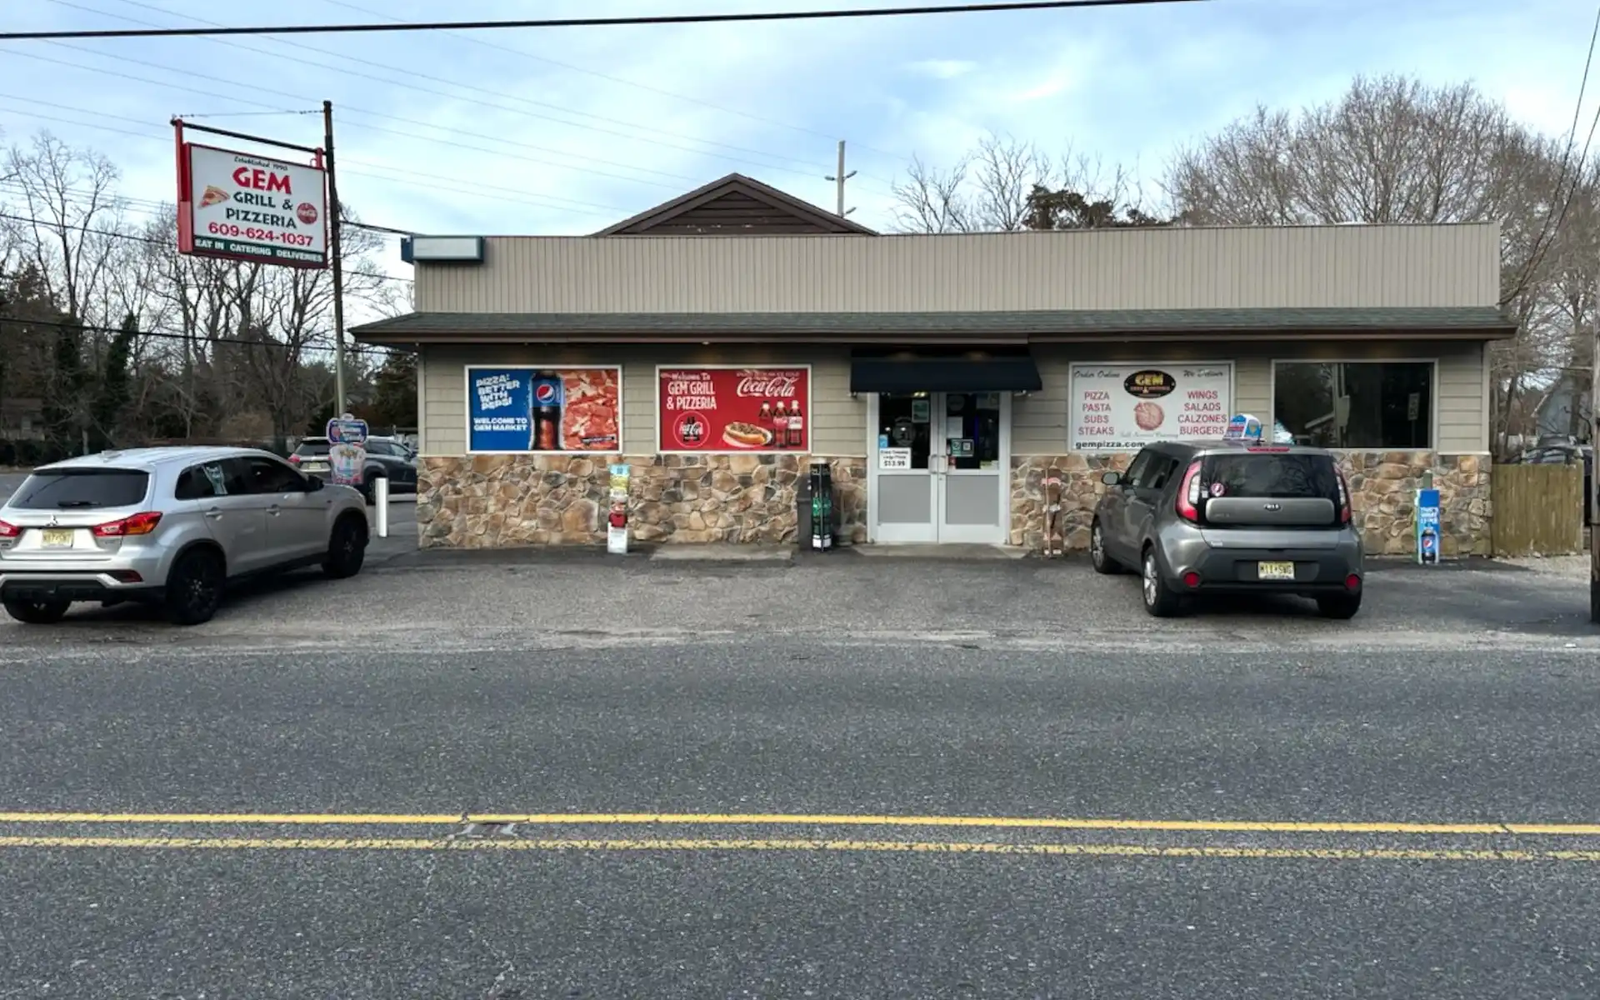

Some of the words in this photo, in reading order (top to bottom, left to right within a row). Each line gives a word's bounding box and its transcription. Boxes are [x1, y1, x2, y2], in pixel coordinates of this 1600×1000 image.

[232, 166, 292, 195] GEM
[233, 191, 276, 208] GRILL
[282, 199, 293, 211] &
[226, 207, 297, 229] PIZZERIA
[208, 221, 313, 247] 609-624-1037
[195, 239, 212, 249] EAT
[215, 241, 224, 250] IN
[230, 243, 272, 256] CATERING
[276, 250, 323, 263] DELIVERIES
[1098, 370, 1120, 378] Online
[1135, 373, 1164, 385] GEM
[477, 380, 520, 395] BETTER
[668, 382, 688, 395] GEM
[690, 382, 715, 395] GRILL
[480, 392, 508, 404] WITH
[1084, 391, 1110, 400] PIZZA
[1187, 390, 1218, 399] WINGS
[666, 397, 674, 410] &
[676, 397, 717, 410] PIZZERIA
[1082, 403, 1111, 412] PASTA
[1184, 402, 1221, 411] SALADS
[1084, 415, 1109, 424] SUBS
[1178, 414, 1227, 423] CALZONES
[1078, 427, 1114, 436] STEAKS
[1180, 426, 1225, 435] BURGERS
[1075, 441, 1146, 450] gempizza.com
